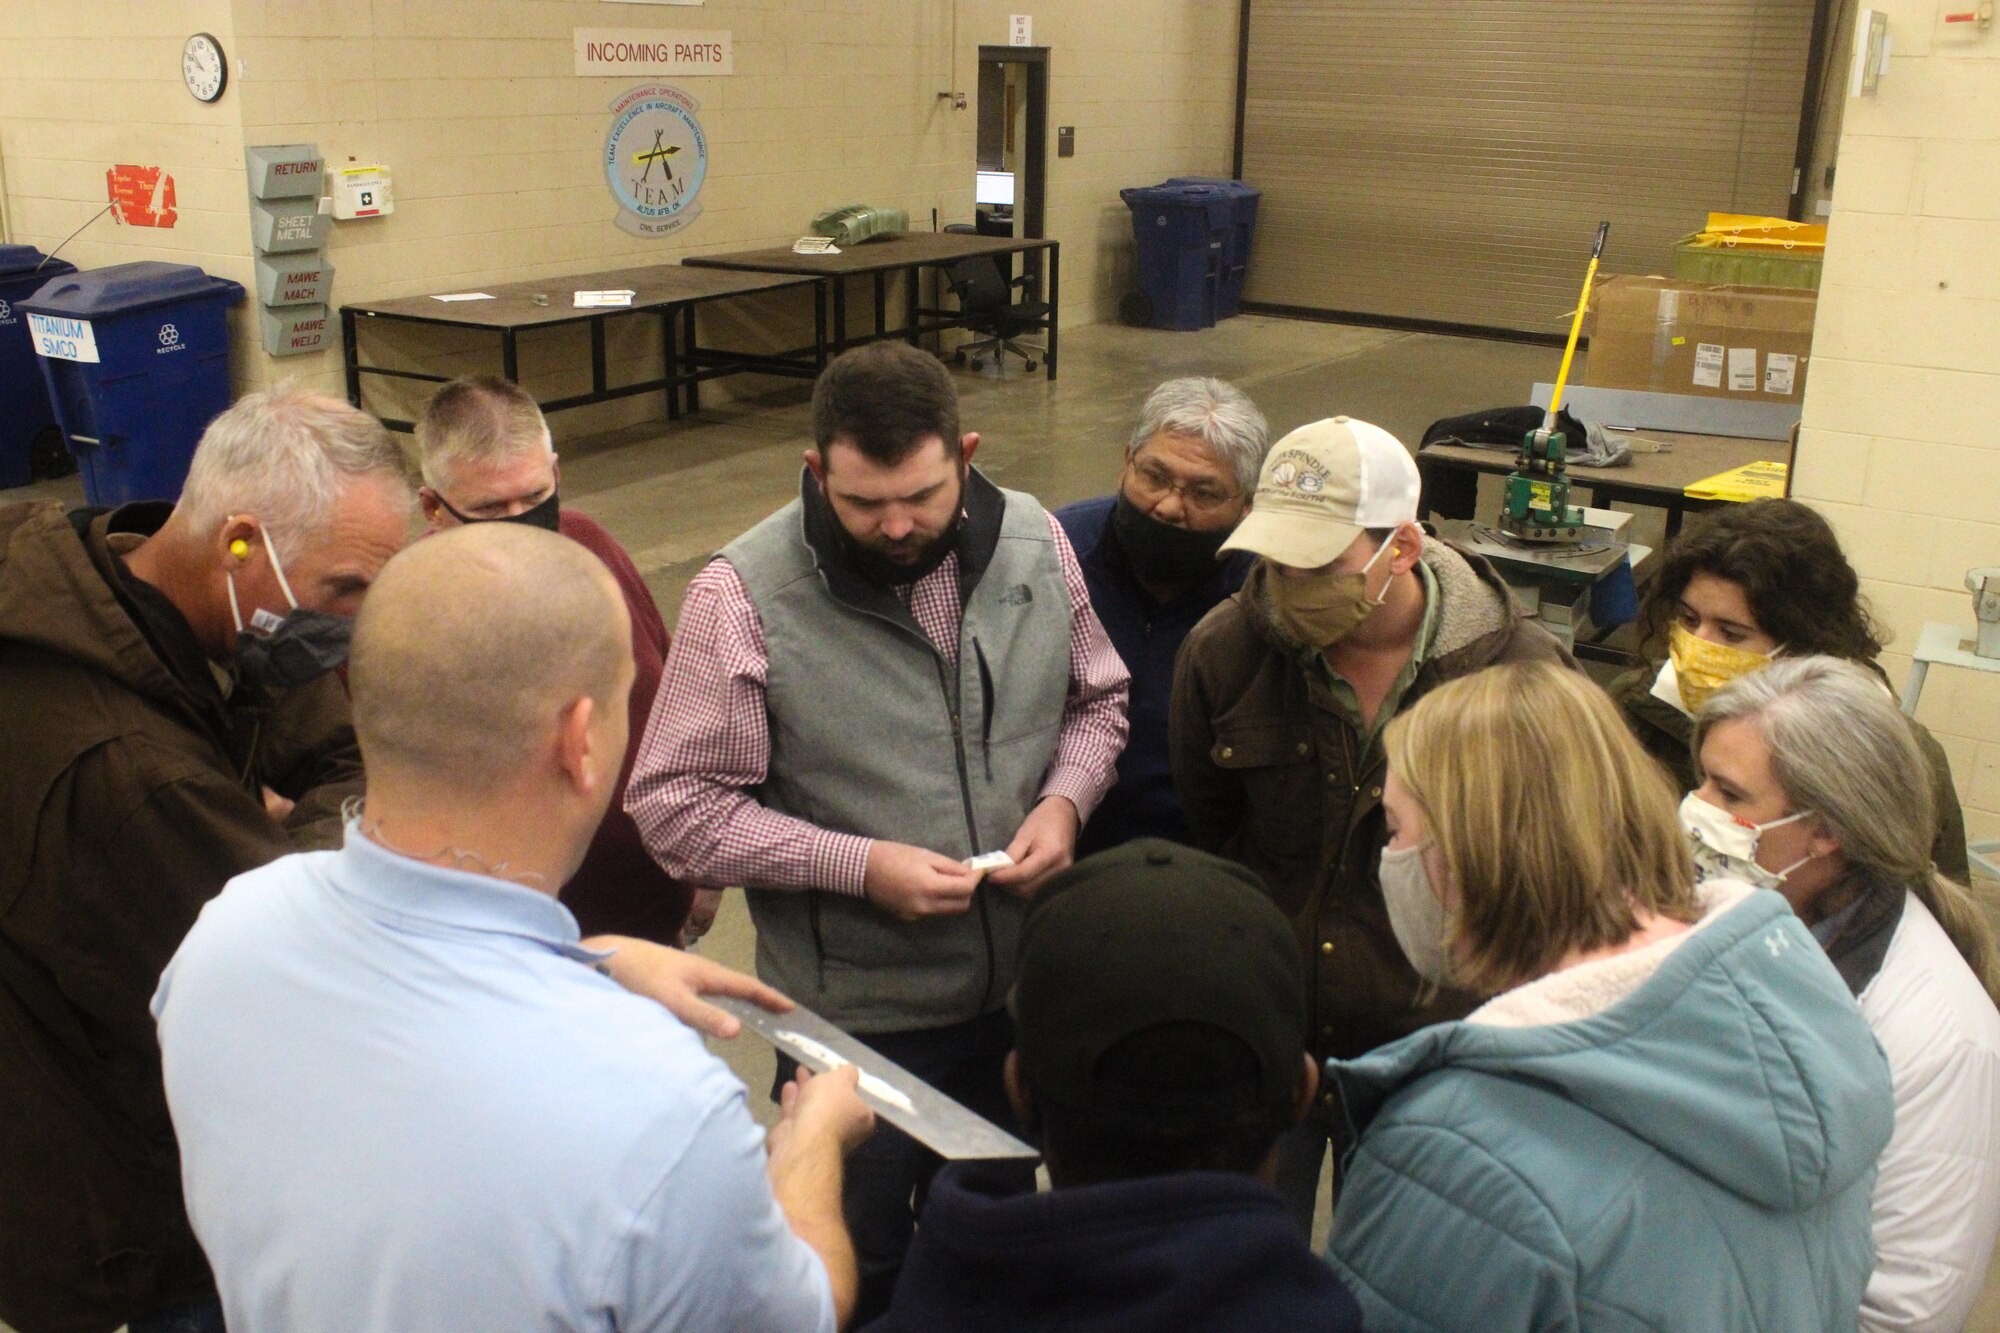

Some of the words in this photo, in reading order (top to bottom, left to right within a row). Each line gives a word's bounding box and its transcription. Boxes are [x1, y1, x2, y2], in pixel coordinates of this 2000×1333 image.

[1016, 16, 1025, 24] NOT
[1016, 36, 1026, 44] EXIT
[587, 42, 668, 63] INCOMING
[675, 44, 722, 63] PARTS
[614, 88, 657, 114] MAINTENANCE
[659, 88, 694, 110] OPERATIONS
[608, 144, 617, 165] TEAM
[614, 106, 645, 142] EXCELLENCE
[646, 102, 653, 110] IN
[655, 102, 683, 117] AIRCRAFT
[683, 114, 705, 159] MAINTENANCE
[275, 162, 318, 175] RETURN
[632, 176, 685, 205] TEAM
[636, 204, 655, 216] ALTUS
[673, 202, 681, 212] OK
[278, 215, 314, 228] SHEET
[640, 223, 654, 233] CIVIL
[656, 220, 681, 232] SERVICE
[277, 227, 313, 241] METAL
[287, 271, 321, 284] MAWE
[284, 288, 316, 301] MACH
[31, 314, 84, 339] TITANIUM
[293, 319, 326, 333] MAWE
[42, 337, 77, 359] SMCO
[291, 335, 321, 348] WELD
[156, 343, 186, 355] RECYCLE
[1288, 449, 1332, 480] SPINDLE
